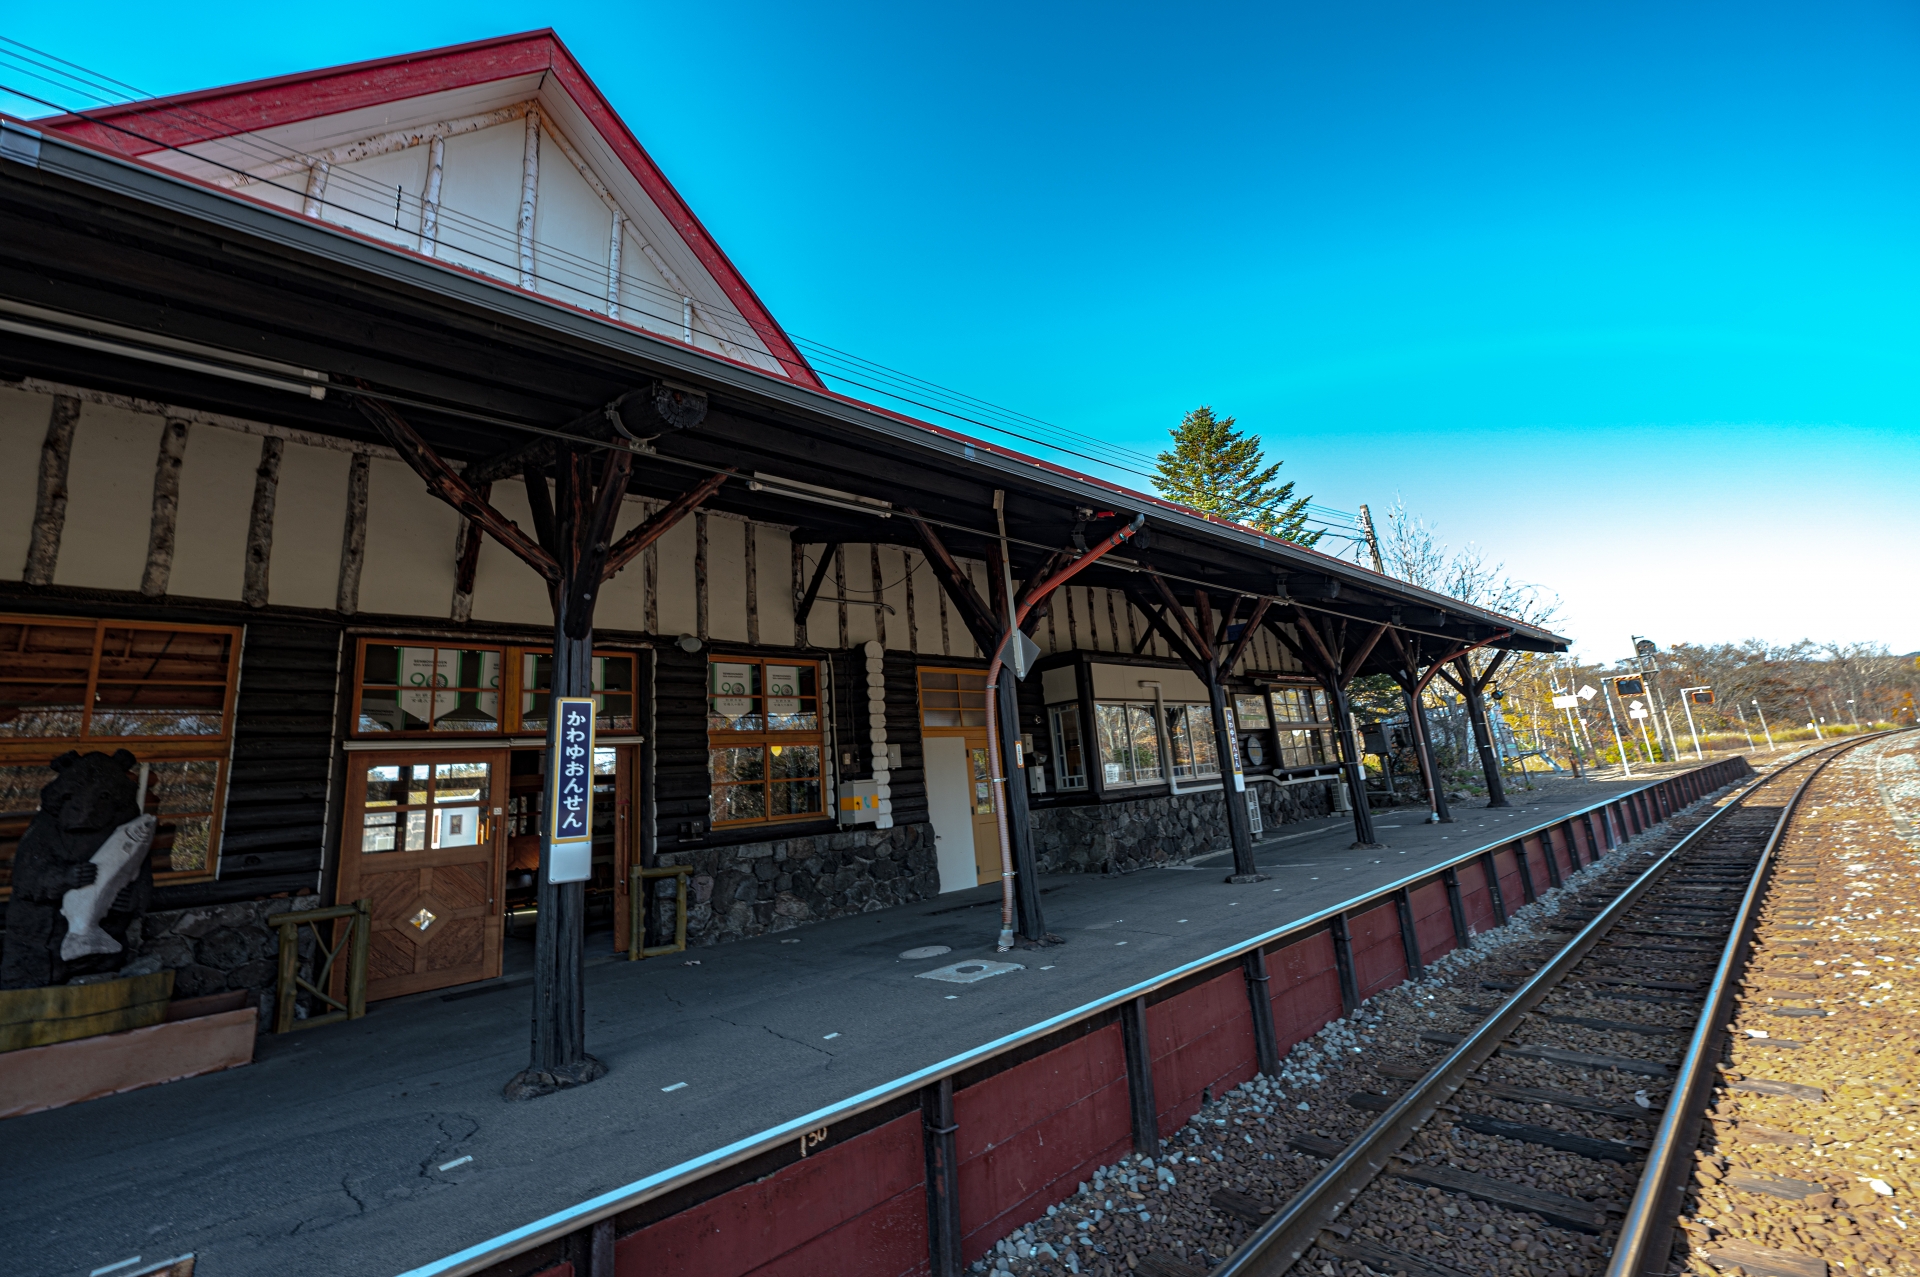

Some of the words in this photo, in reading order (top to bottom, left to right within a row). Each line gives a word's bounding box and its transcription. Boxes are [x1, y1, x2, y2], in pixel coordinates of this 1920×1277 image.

[562, 710, 587, 829] かわゆおんせん
